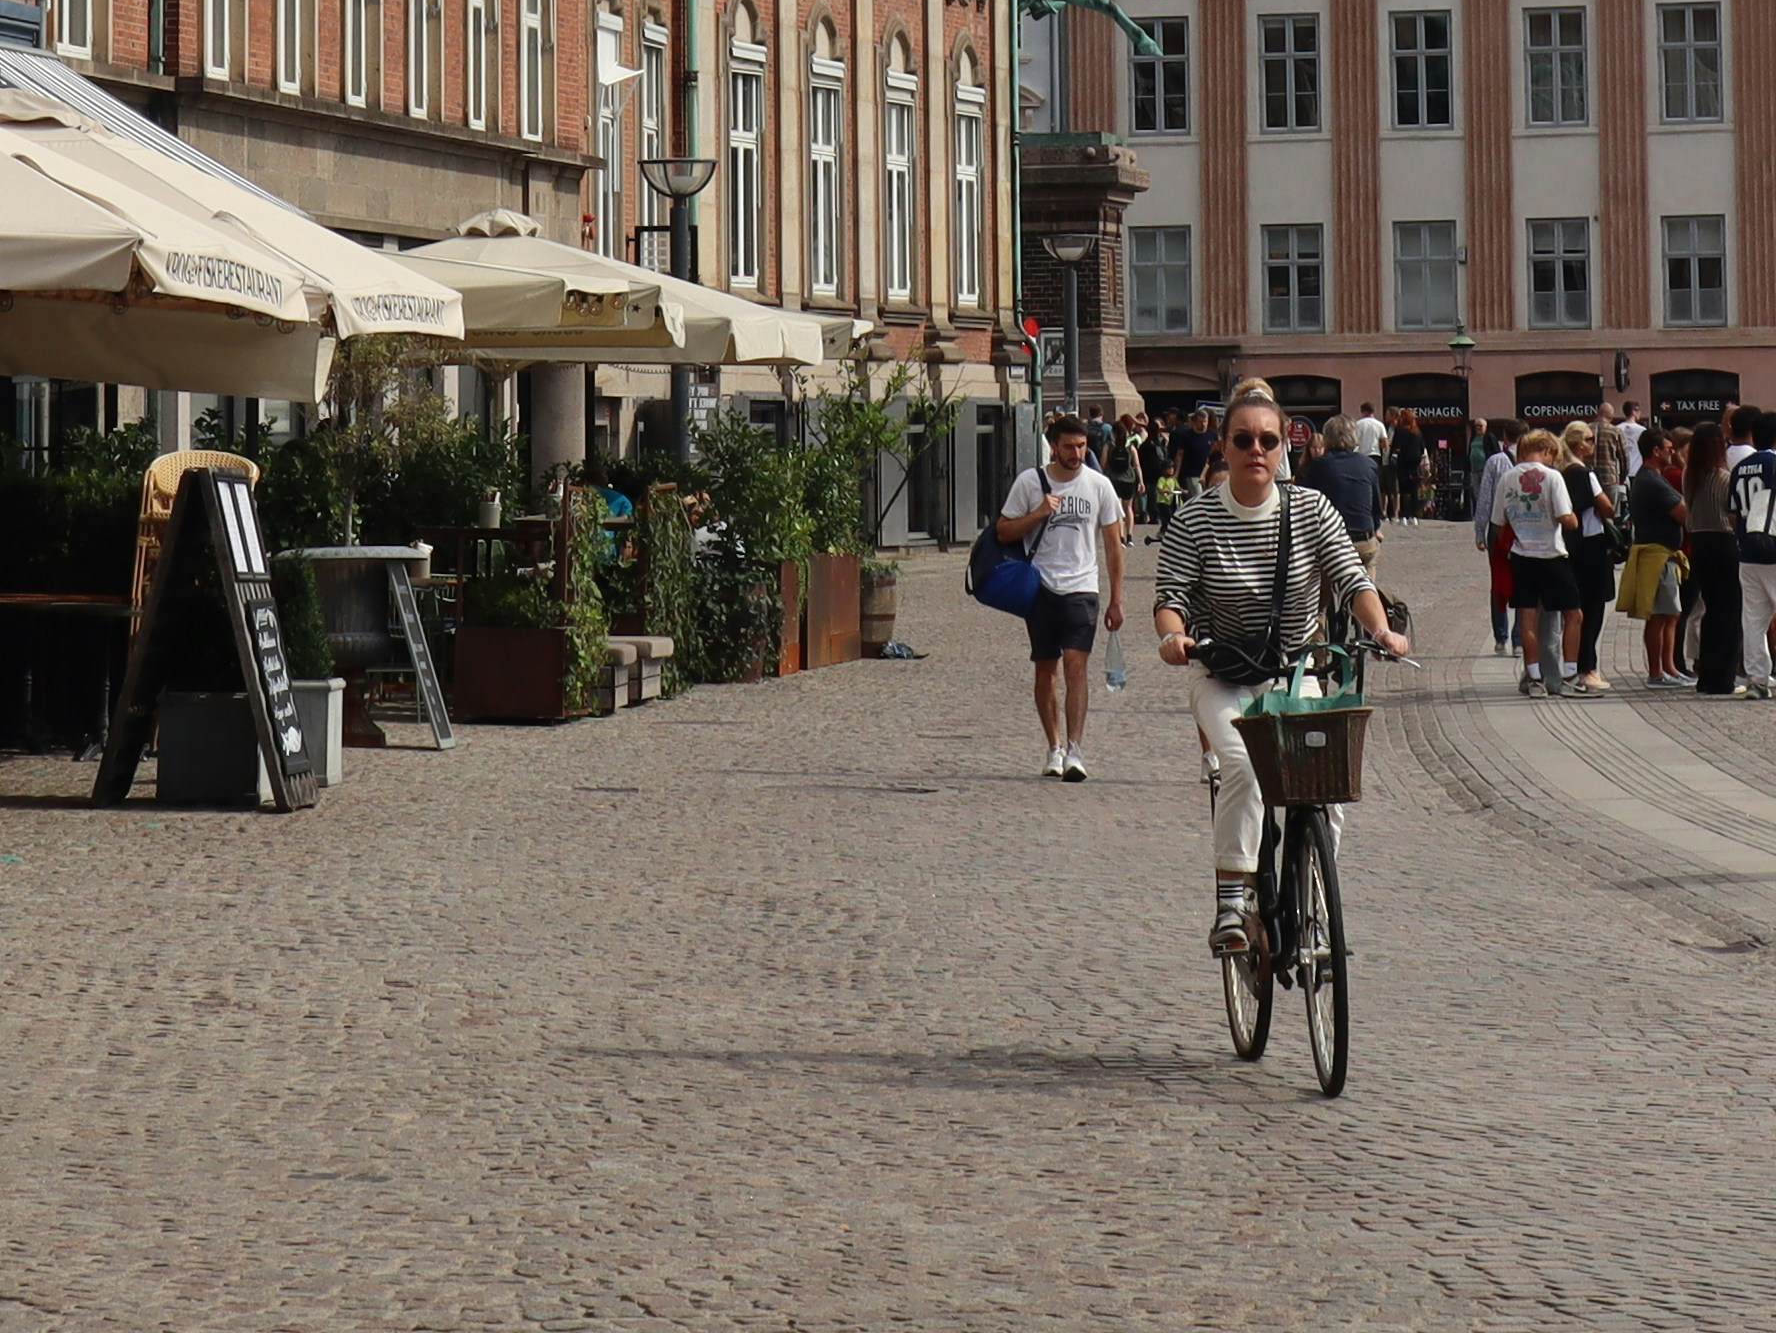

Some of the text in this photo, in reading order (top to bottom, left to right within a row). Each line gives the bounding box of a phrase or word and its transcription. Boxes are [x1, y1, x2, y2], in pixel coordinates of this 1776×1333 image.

[1523, 404, 1599, 417] COPENHAGEN
[1676, 399, 1721, 411] TAX FREE
[1060, 495, 1092, 515] ERIOR
